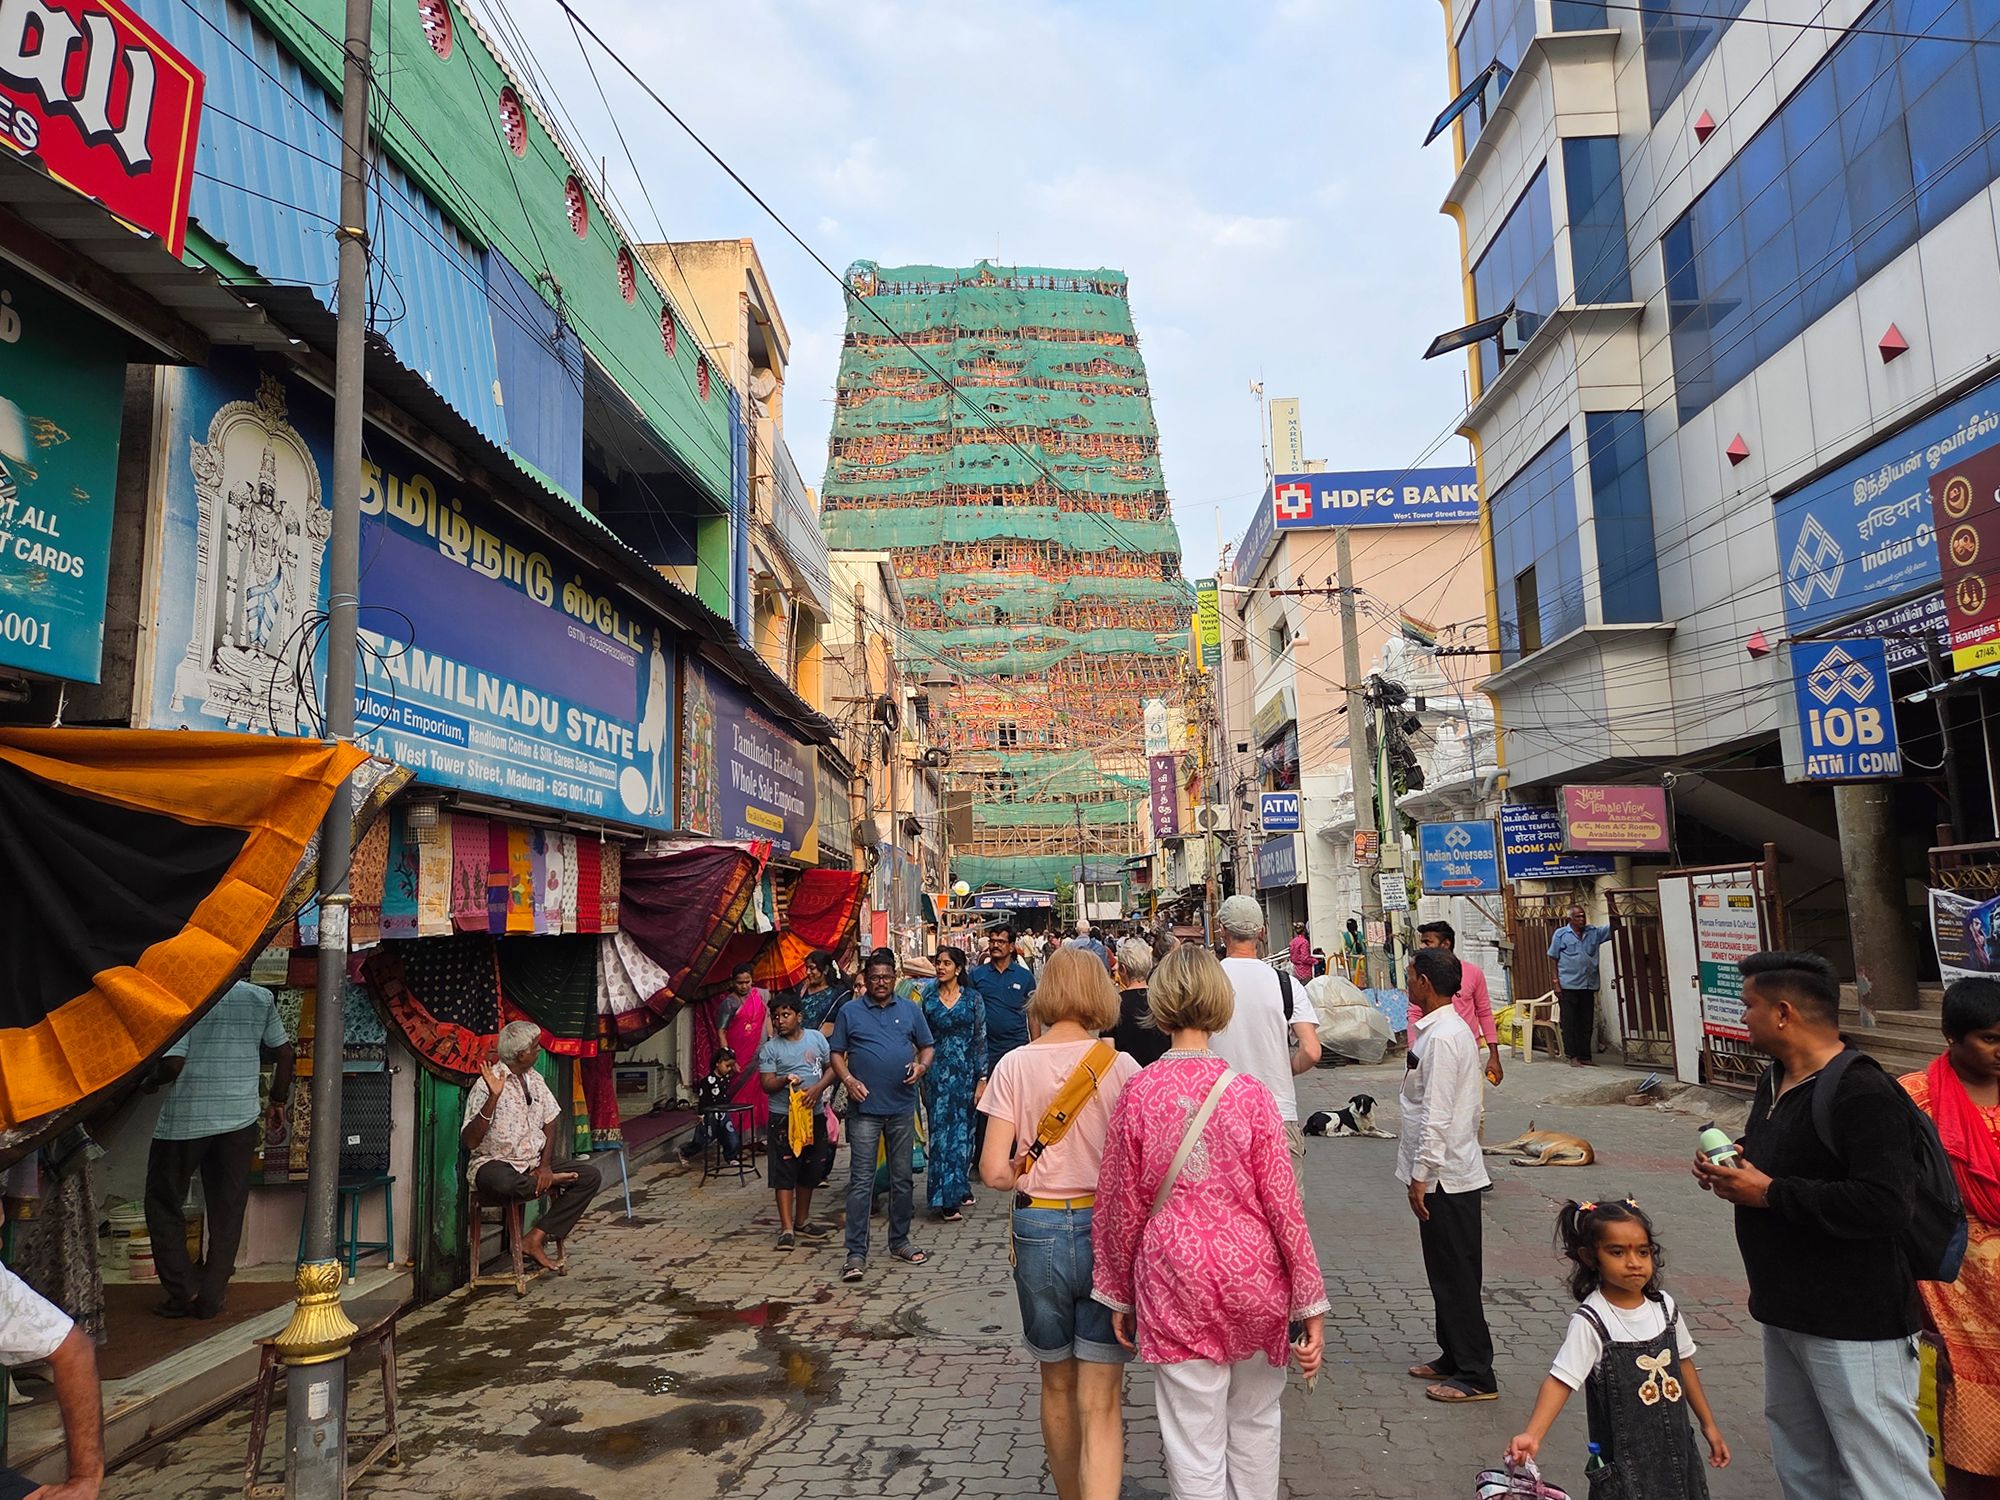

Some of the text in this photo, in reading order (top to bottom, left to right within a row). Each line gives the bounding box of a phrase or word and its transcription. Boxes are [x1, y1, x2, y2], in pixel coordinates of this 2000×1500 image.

[1288, 420, 1299, 472] MARKETING
[1321, 483, 1478, 509] HDFC BANK
[1853, 451, 1921, 506] இந்தியன்
[20, 506, 60, 538] ALL
[1393, 509, 1478, 520] West Tower Street Branc
[1857, 493, 1921, 541] इण्डियन
[15, 538, 84, 578] CARDS
[358, 459, 643, 654] தமிழ்நாடு ஸ்டேட்
[1861, 536, 1913, 573] Indian
[567, 625, 586, 644] GSTIN
[356, 627, 634, 760] TAMILNADU STATE
[403, 708, 465, 744] Emporium,
[1808, 707, 1884, 746] IOB
[470, 724, 615, 781] Handloom Cotton & Silk Sarees Sale Showroom
[733, 722, 773, 769] Tamilnadu
[1807, 753, 1845, 775] ATM
[1858, 752, 1898, 773] CDM
[394, 740, 427, 768] West
[430, 750, 465, 777] Tower
[467, 759, 504, 786] Street,
[507, 768, 545, 793] Madurai
[552, 779, 569, 798] 625
[731, 759, 805, 816] Whole Sale Emporium
[1263, 799, 1298, 813] ATM
[1591, 800, 1645, 814] Temple View
[1504, 824, 1527, 832] HOTEL
[1528, 822, 1556, 831] TEMPLE
[1275, 847, 1294, 874] BANK
[1425, 848, 1494, 862] Indian Overseas
[1507, 843, 1545, 855] ROOMS
[1449, 862, 1472, 875] Bank
